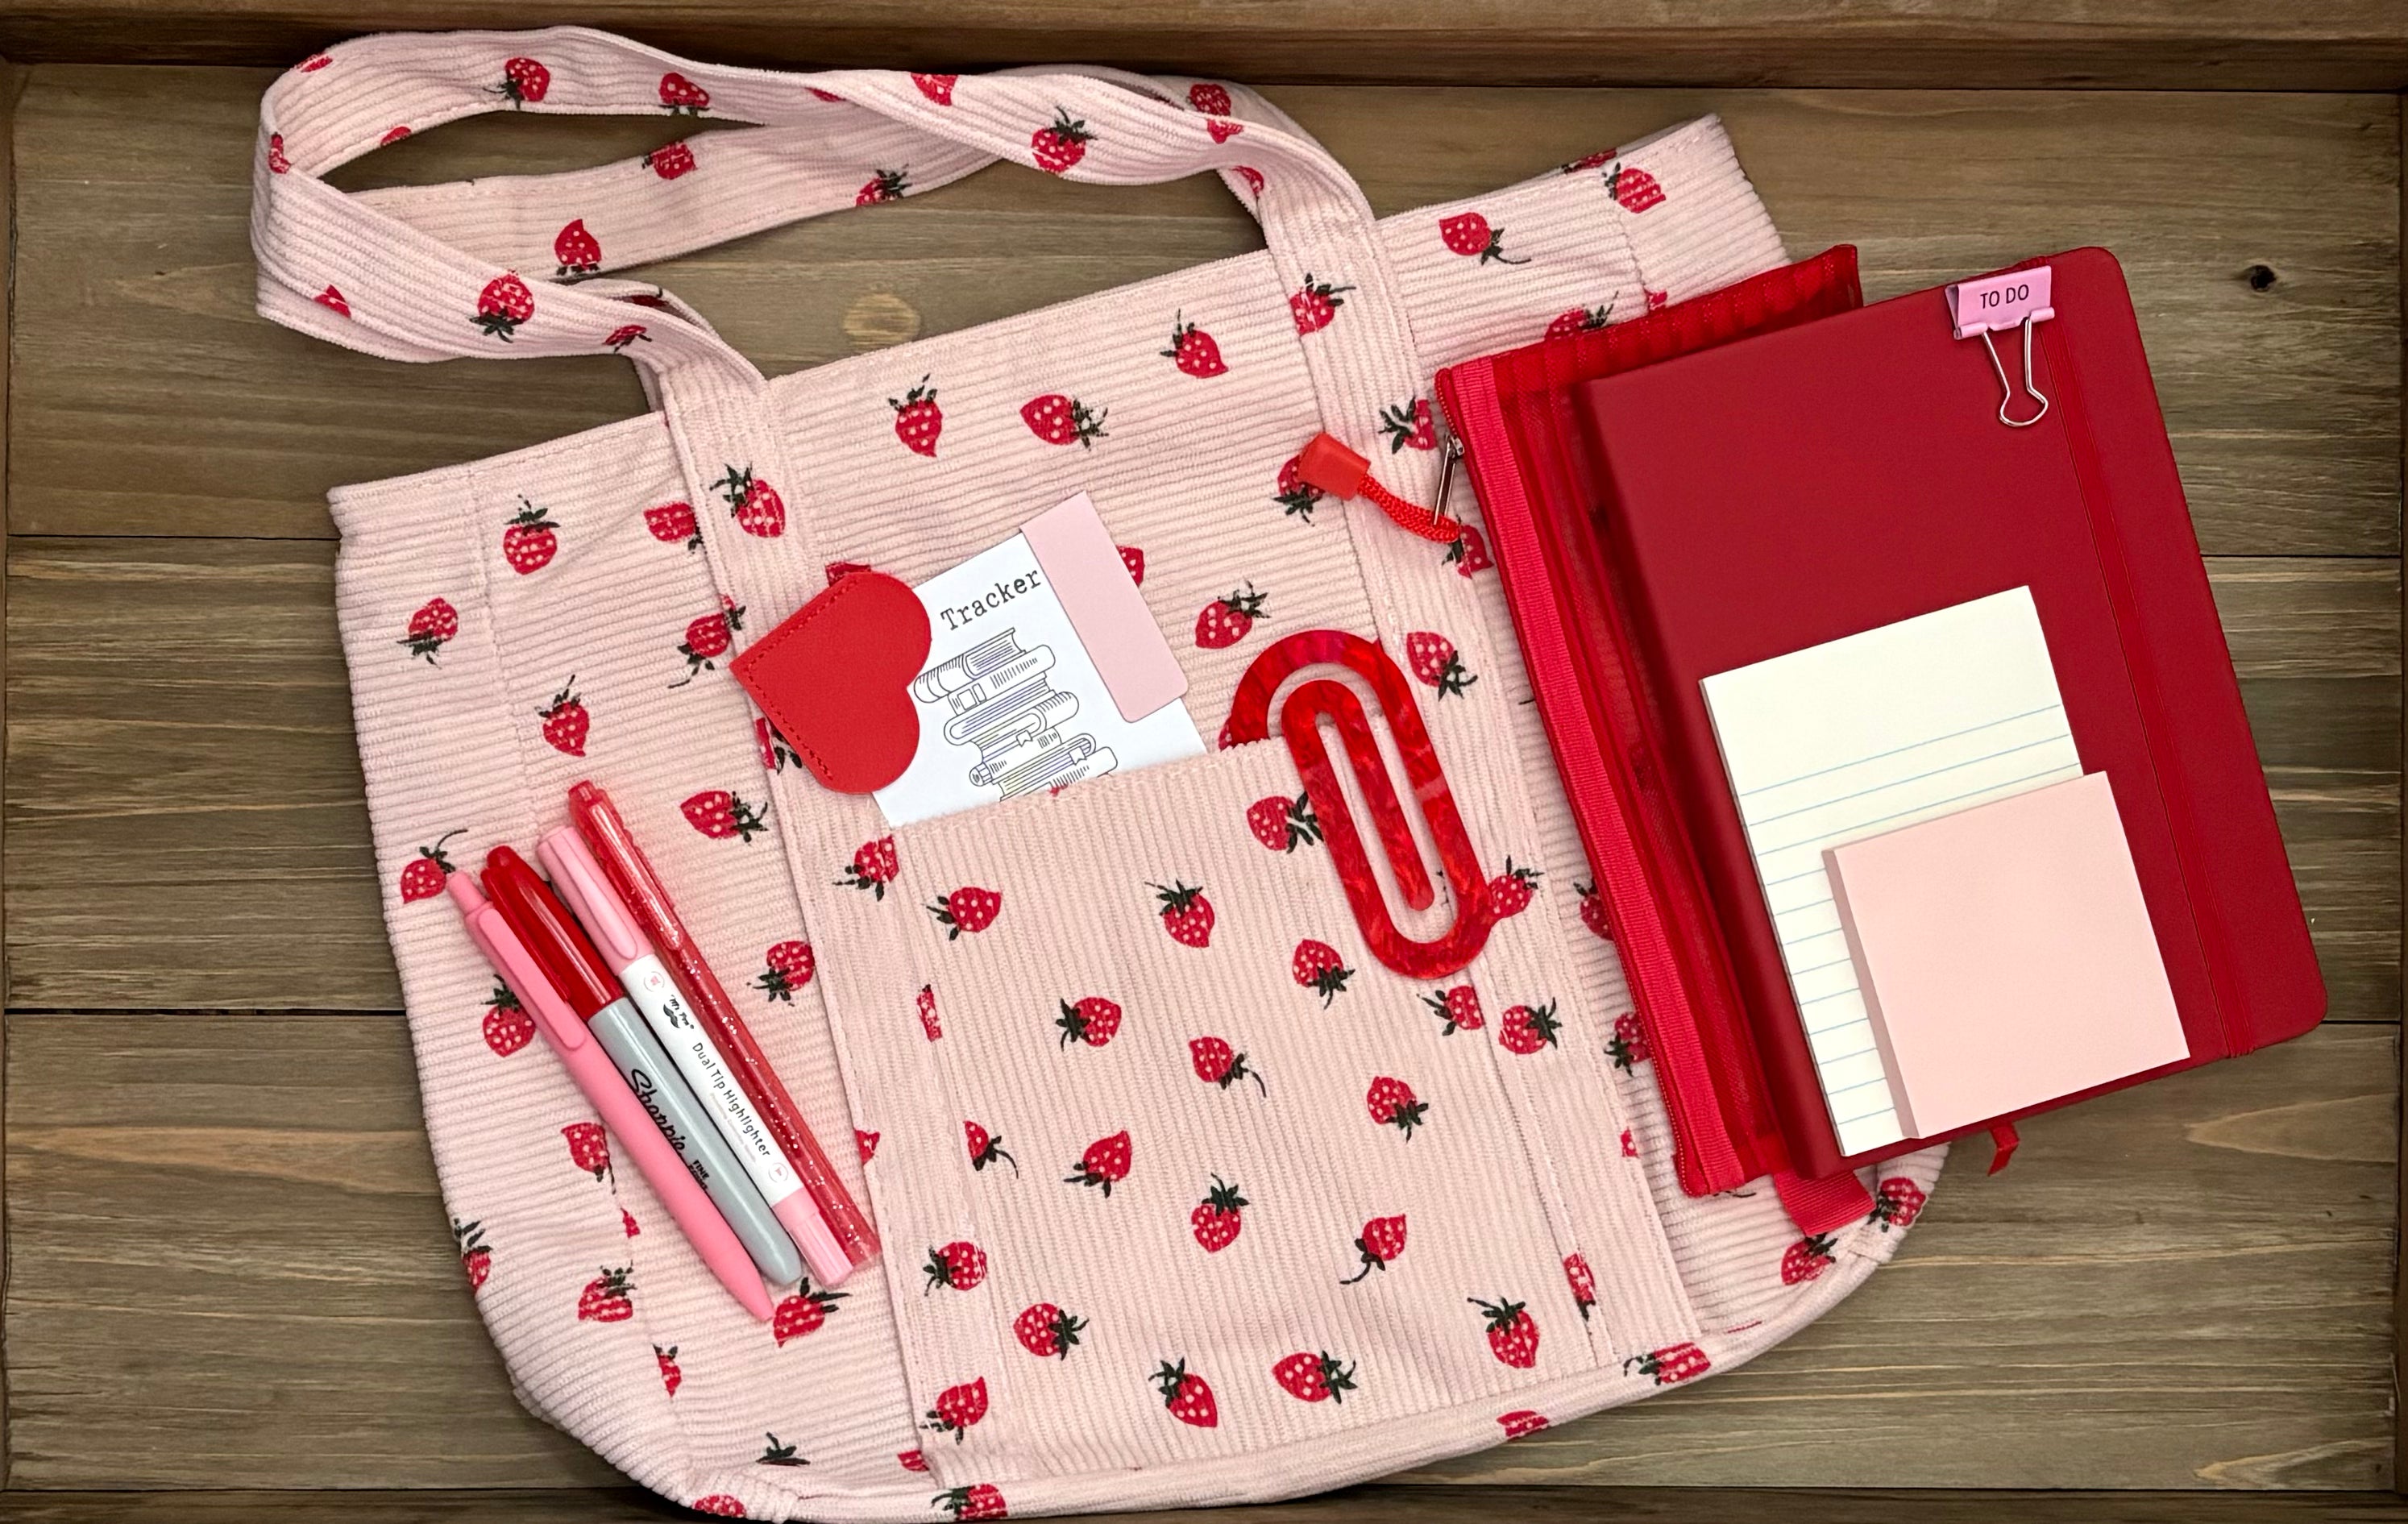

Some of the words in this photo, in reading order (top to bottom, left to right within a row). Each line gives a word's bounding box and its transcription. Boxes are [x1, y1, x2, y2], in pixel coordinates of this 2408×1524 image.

[1980, 290, 2000, 309] TO
[2006, 284, 2029, 304] DO
[940, 570, 1042, 631] Tracker
[631, 1069, 686, 1152] Sharpie
[692, 1042, 716, 1070] Dual
[711, 1069, 725, 1090] Tip
[724, 1090, 770, 1156] Highlighter
[692, 1159, 710, 1179] FINE
